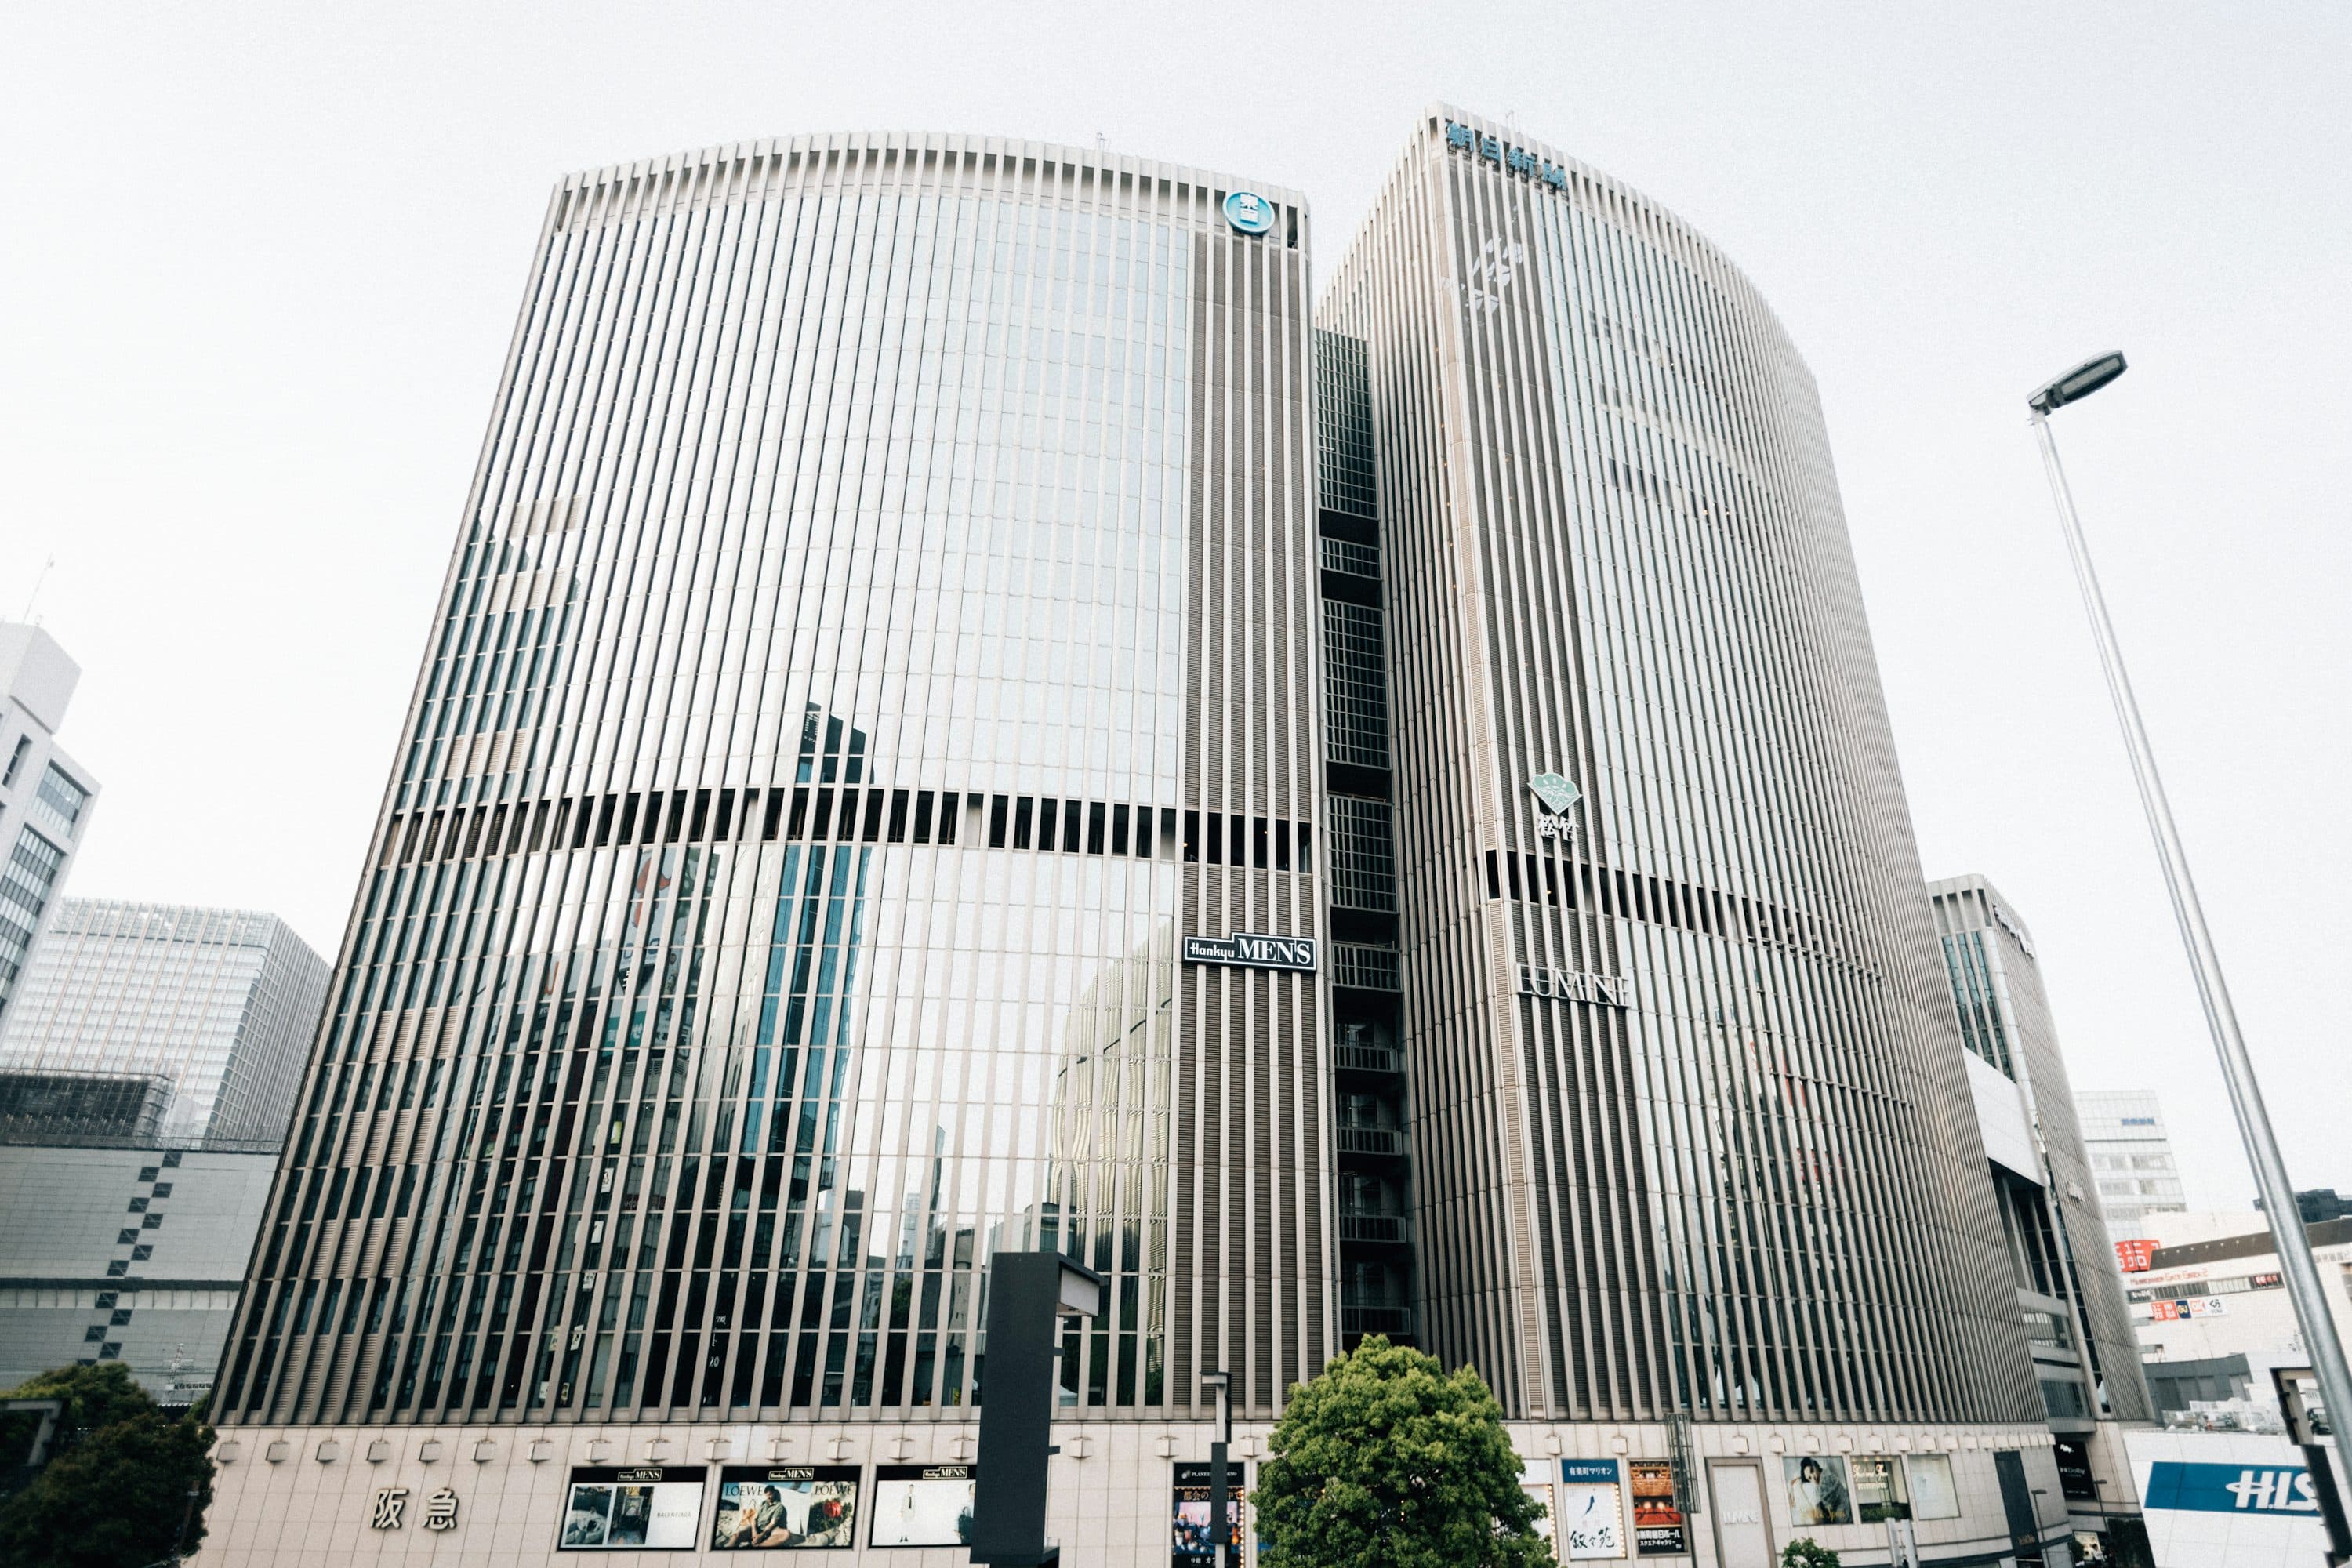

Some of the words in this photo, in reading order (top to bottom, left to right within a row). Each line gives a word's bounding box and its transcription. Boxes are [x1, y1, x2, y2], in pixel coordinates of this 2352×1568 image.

[1190, 942, 1234, 961] Hankyu
[1515, 963, 1631, 1007] LUMINE
[2177, 1305, 2188, 1314] GU
[1570, 1467, 1613, 1476] 有楽町マリオン
[724, 1486, 764, 1497] LOEWE
[815, 1486, 852, 1496] LOEWE
[370, 1487, 459, 1530] 阪急
[1570, 1526, 1615, 1549] 叙々苑
